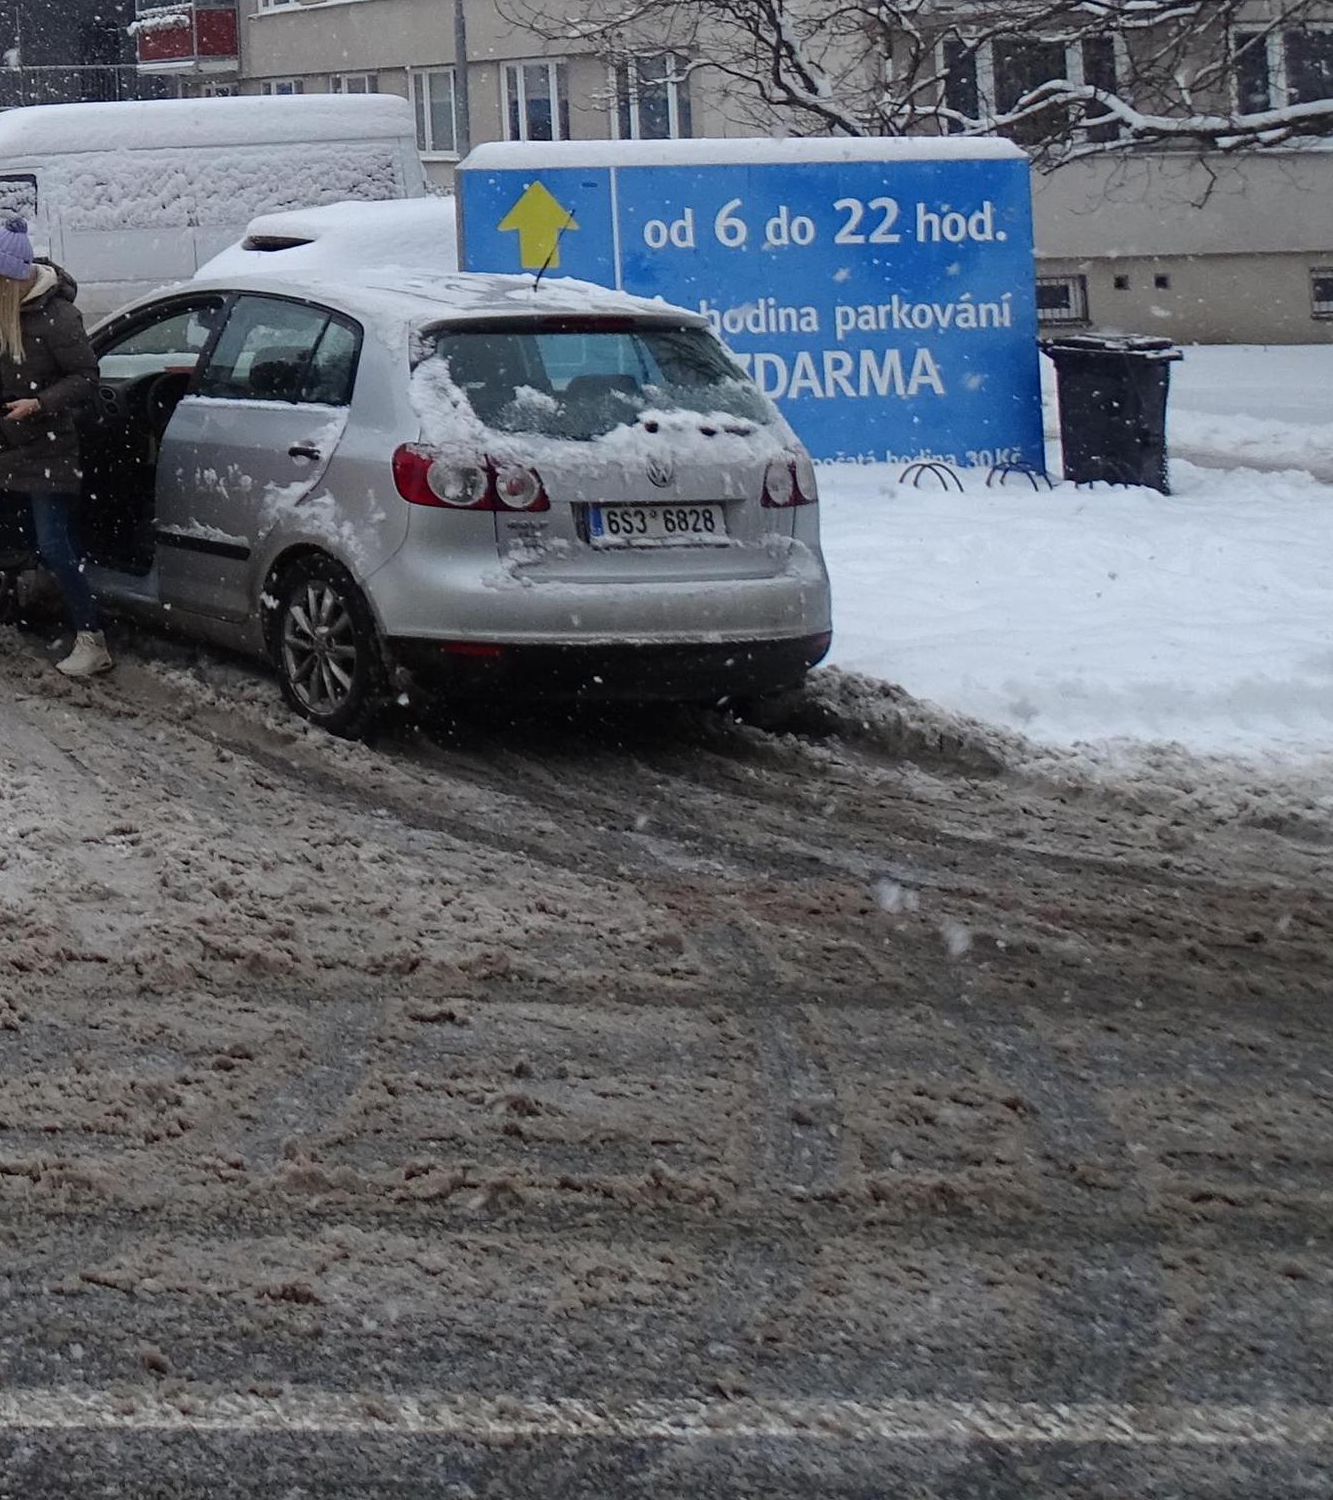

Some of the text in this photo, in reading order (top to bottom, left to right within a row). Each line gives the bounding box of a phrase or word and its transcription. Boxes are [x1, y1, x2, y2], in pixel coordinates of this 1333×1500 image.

[643, 197, 1008, 249] od 6 do 22 hod.
[699, 292, 1013, 340] hodina parkování
[607, 508, 716, 535] 6S3 6828
